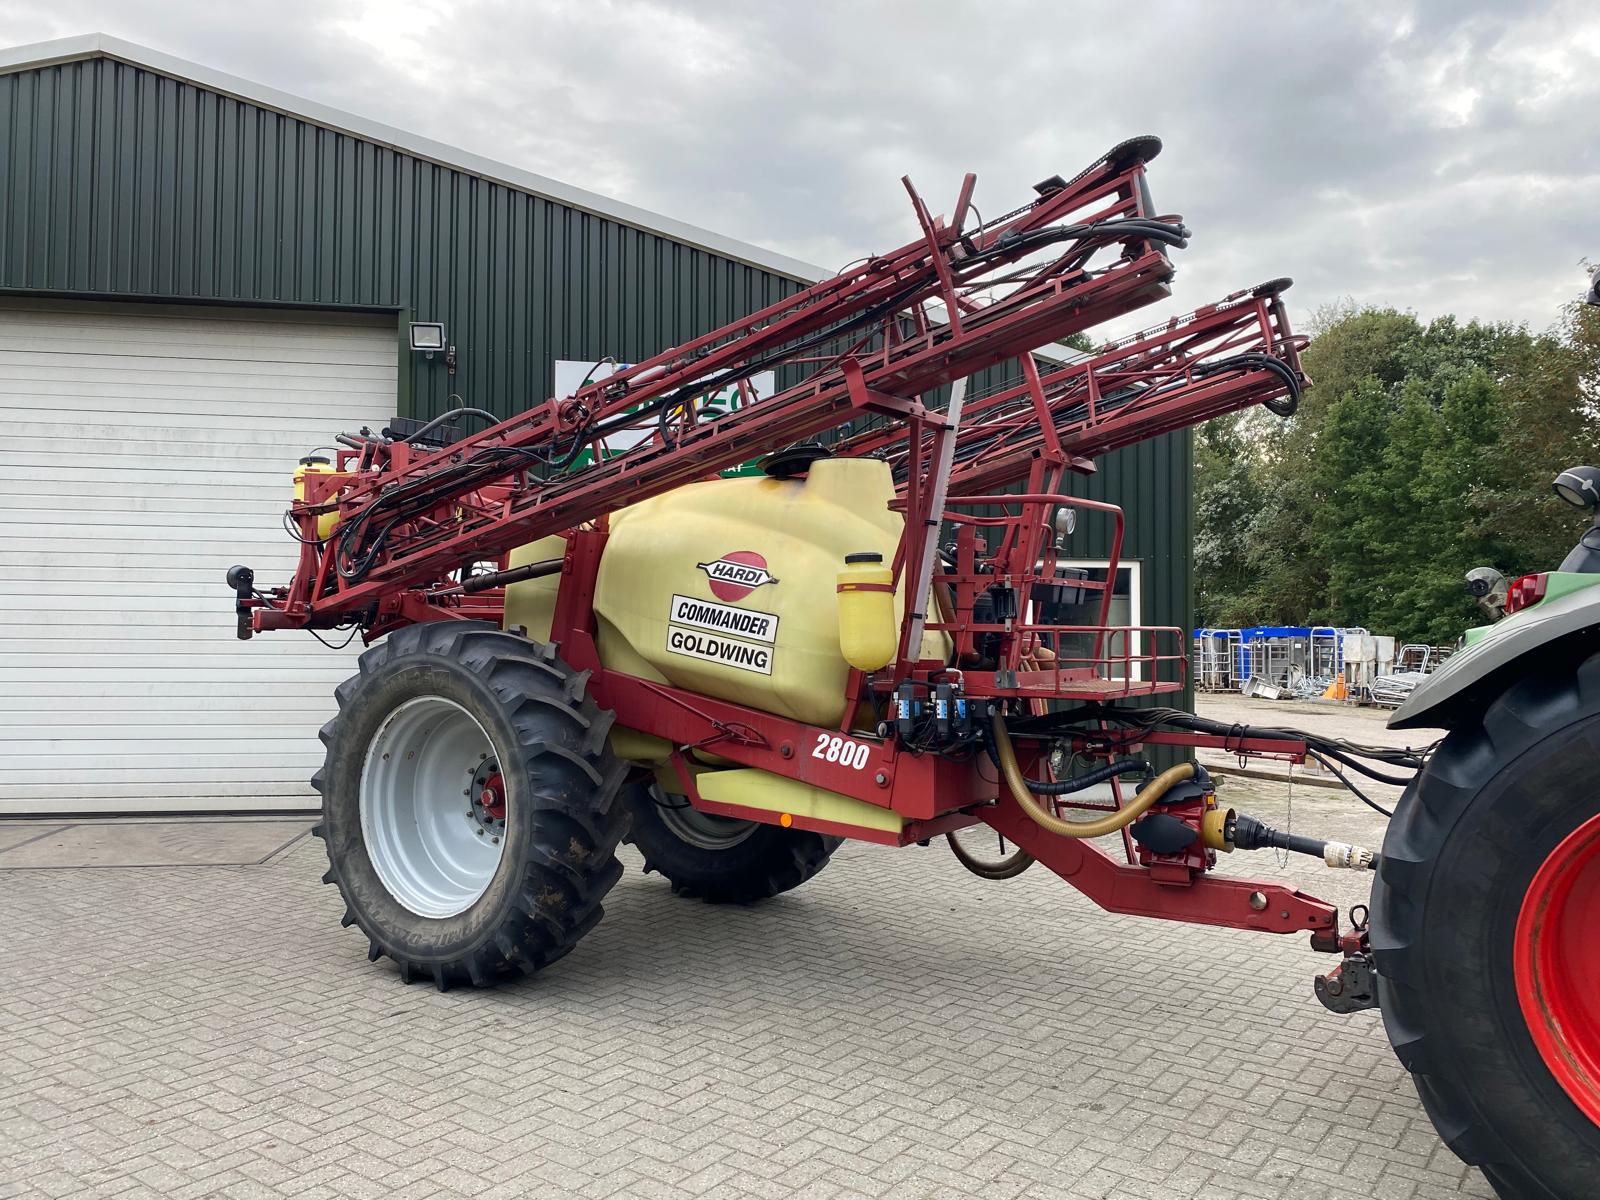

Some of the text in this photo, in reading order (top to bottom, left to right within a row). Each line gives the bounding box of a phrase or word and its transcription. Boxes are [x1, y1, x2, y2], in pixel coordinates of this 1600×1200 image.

[713, 563, 763, 584] HARDI
[677, 602, 770, 636] COMMANDER
[671, 631, 768, 669] GOLDWING
[811, 733, 871, 771] 2800
